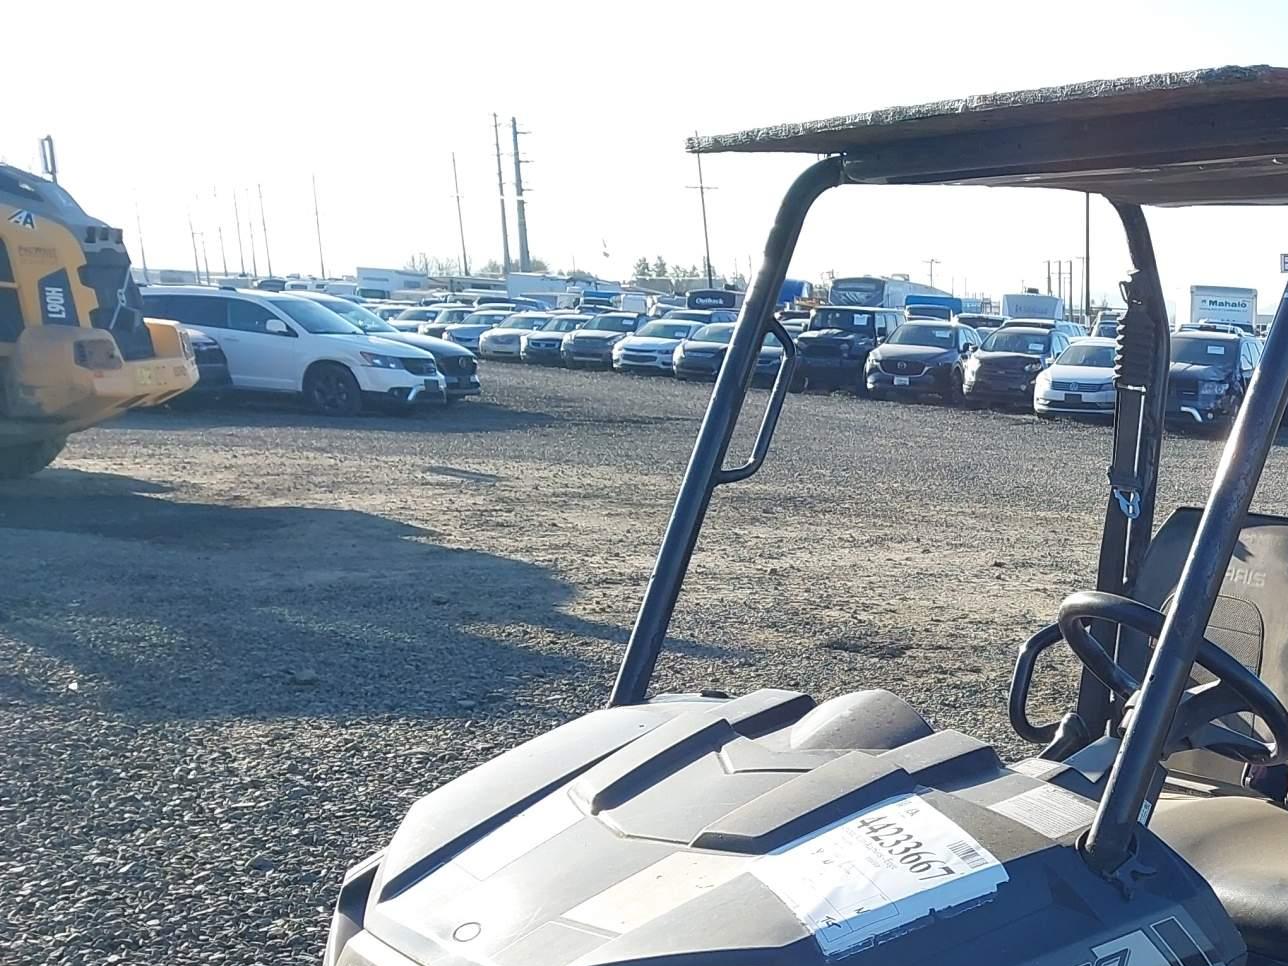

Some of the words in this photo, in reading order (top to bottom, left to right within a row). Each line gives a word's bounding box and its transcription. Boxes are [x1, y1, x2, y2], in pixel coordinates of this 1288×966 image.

[45, 287, 66, 318] L90H
[695, 297, 724, 305] Outback
[1208, 299, 1247, 308] Mahalo
[1225, 566, 1266, 587] ARIS
[857, 815, 956, 881] 44233667
